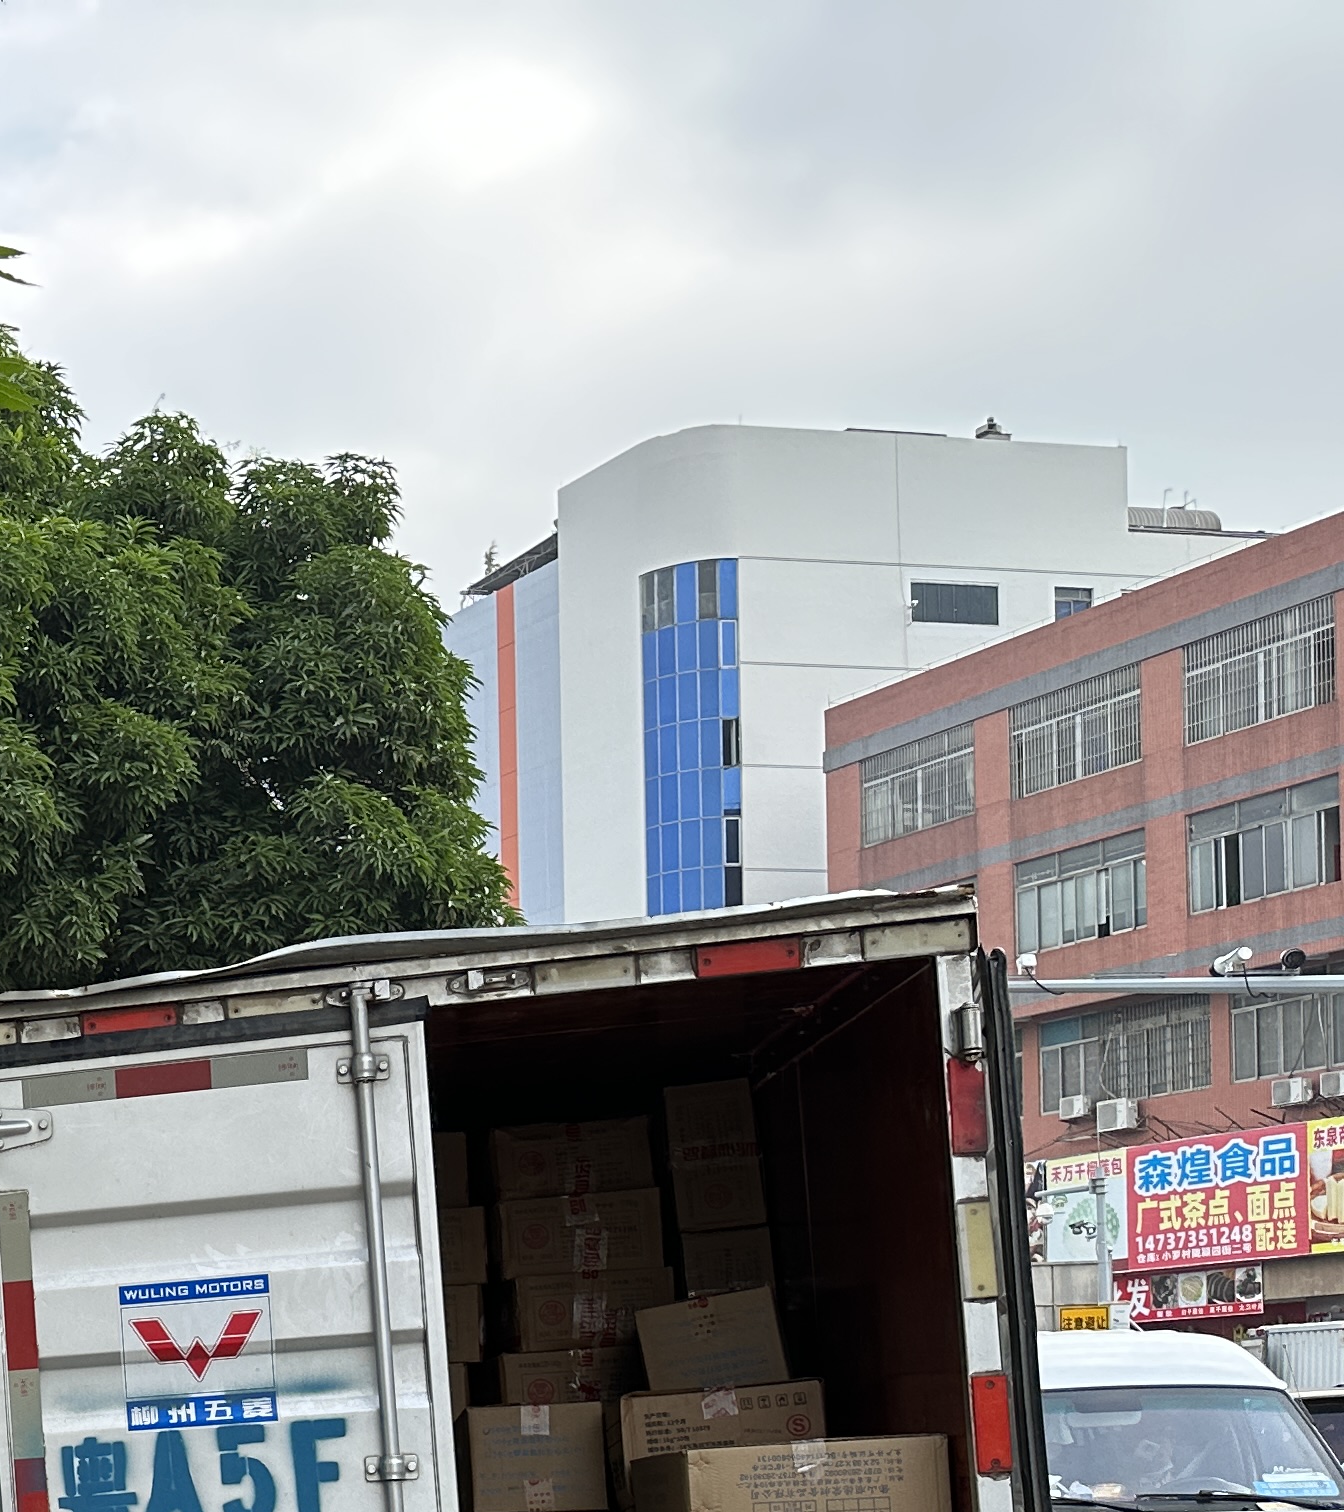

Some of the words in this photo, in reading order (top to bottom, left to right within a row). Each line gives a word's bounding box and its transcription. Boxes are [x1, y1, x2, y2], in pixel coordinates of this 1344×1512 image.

[1135, 1134, 1298, 1194] 森煌食品
[1135, 1182, 1297, 1234] 广式茶点、面点
[1135, 1224, 1253, 1254] 14737351248
[1254, 1219, 1298, 1251] 配送
[122, 1282, 190, 1302] WULING
[193, 1277, 267, 1297] MOTORS
[1062, 1316, 1109, 1330] 注意避让
[129, 1396, 274, 1428] 柳州五菱
